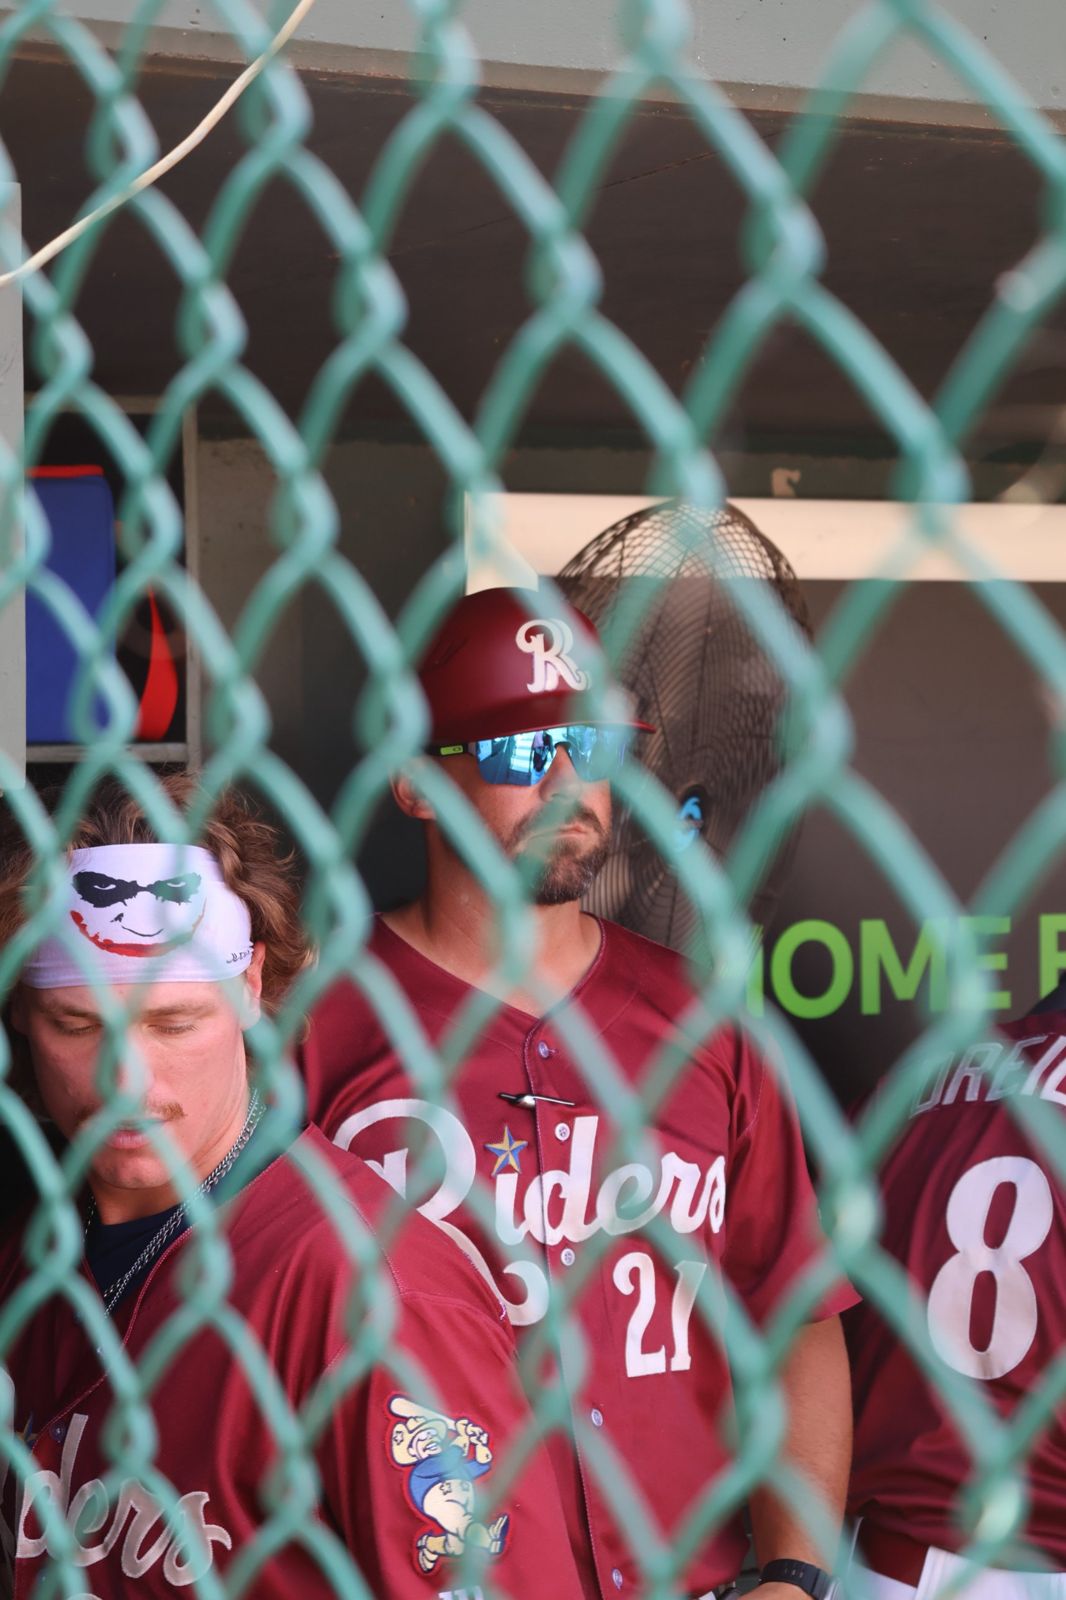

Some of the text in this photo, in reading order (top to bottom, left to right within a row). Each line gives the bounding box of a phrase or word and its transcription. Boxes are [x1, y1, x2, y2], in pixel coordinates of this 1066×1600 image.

[515, 618, 591, 694] R
[745, 915, 1012, 1020] OME
[612, 1251, 708, 1378] 21
[927, 1155, 1054, 1380] 8
[14, 1412, 233, 1587] ders
